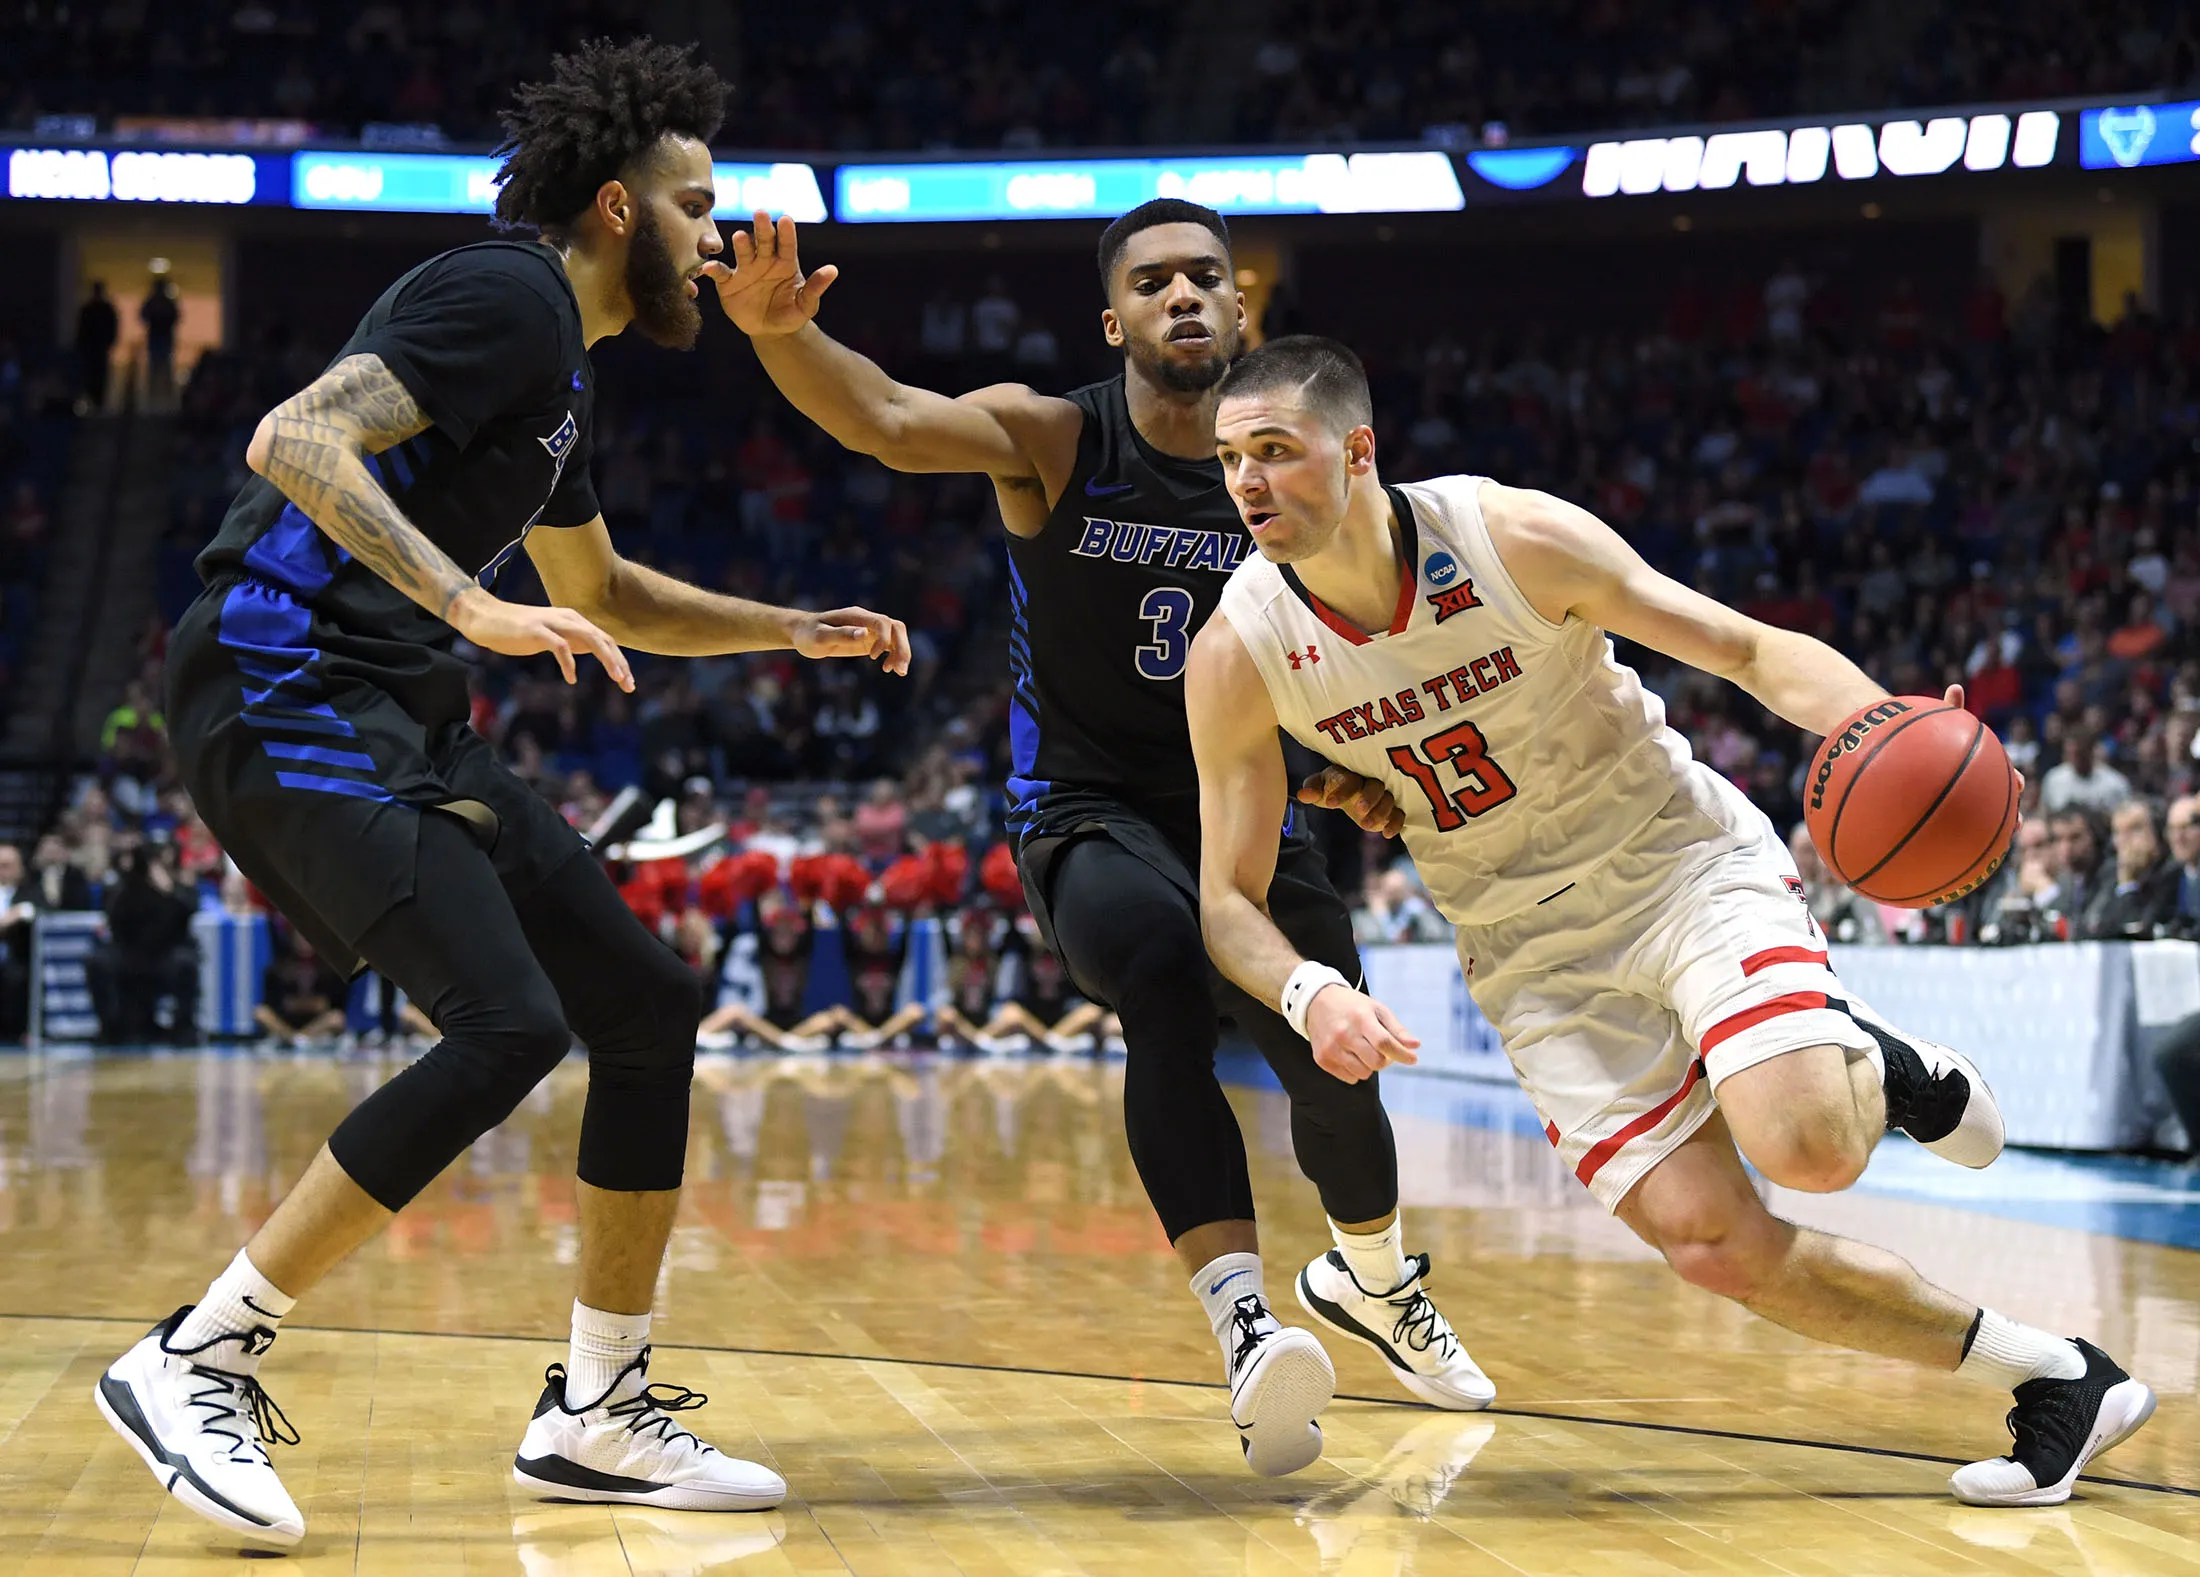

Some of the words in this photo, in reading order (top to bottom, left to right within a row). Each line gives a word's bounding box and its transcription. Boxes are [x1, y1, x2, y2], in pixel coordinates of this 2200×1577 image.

[1069, 516, 1258, 573] BUFFAL
[1430, 563, 1456, 581] NCAA
[1134, 587, 1194, 680] 3
[1426, 578, 1484, 625] XII
[1315, 688, 1426, 744] TEXAS
[1422, 646, 1523, 711] TECH
[1386, 720, 1517, 833] 13
[1810, 700, 1914, 811] Wilson
